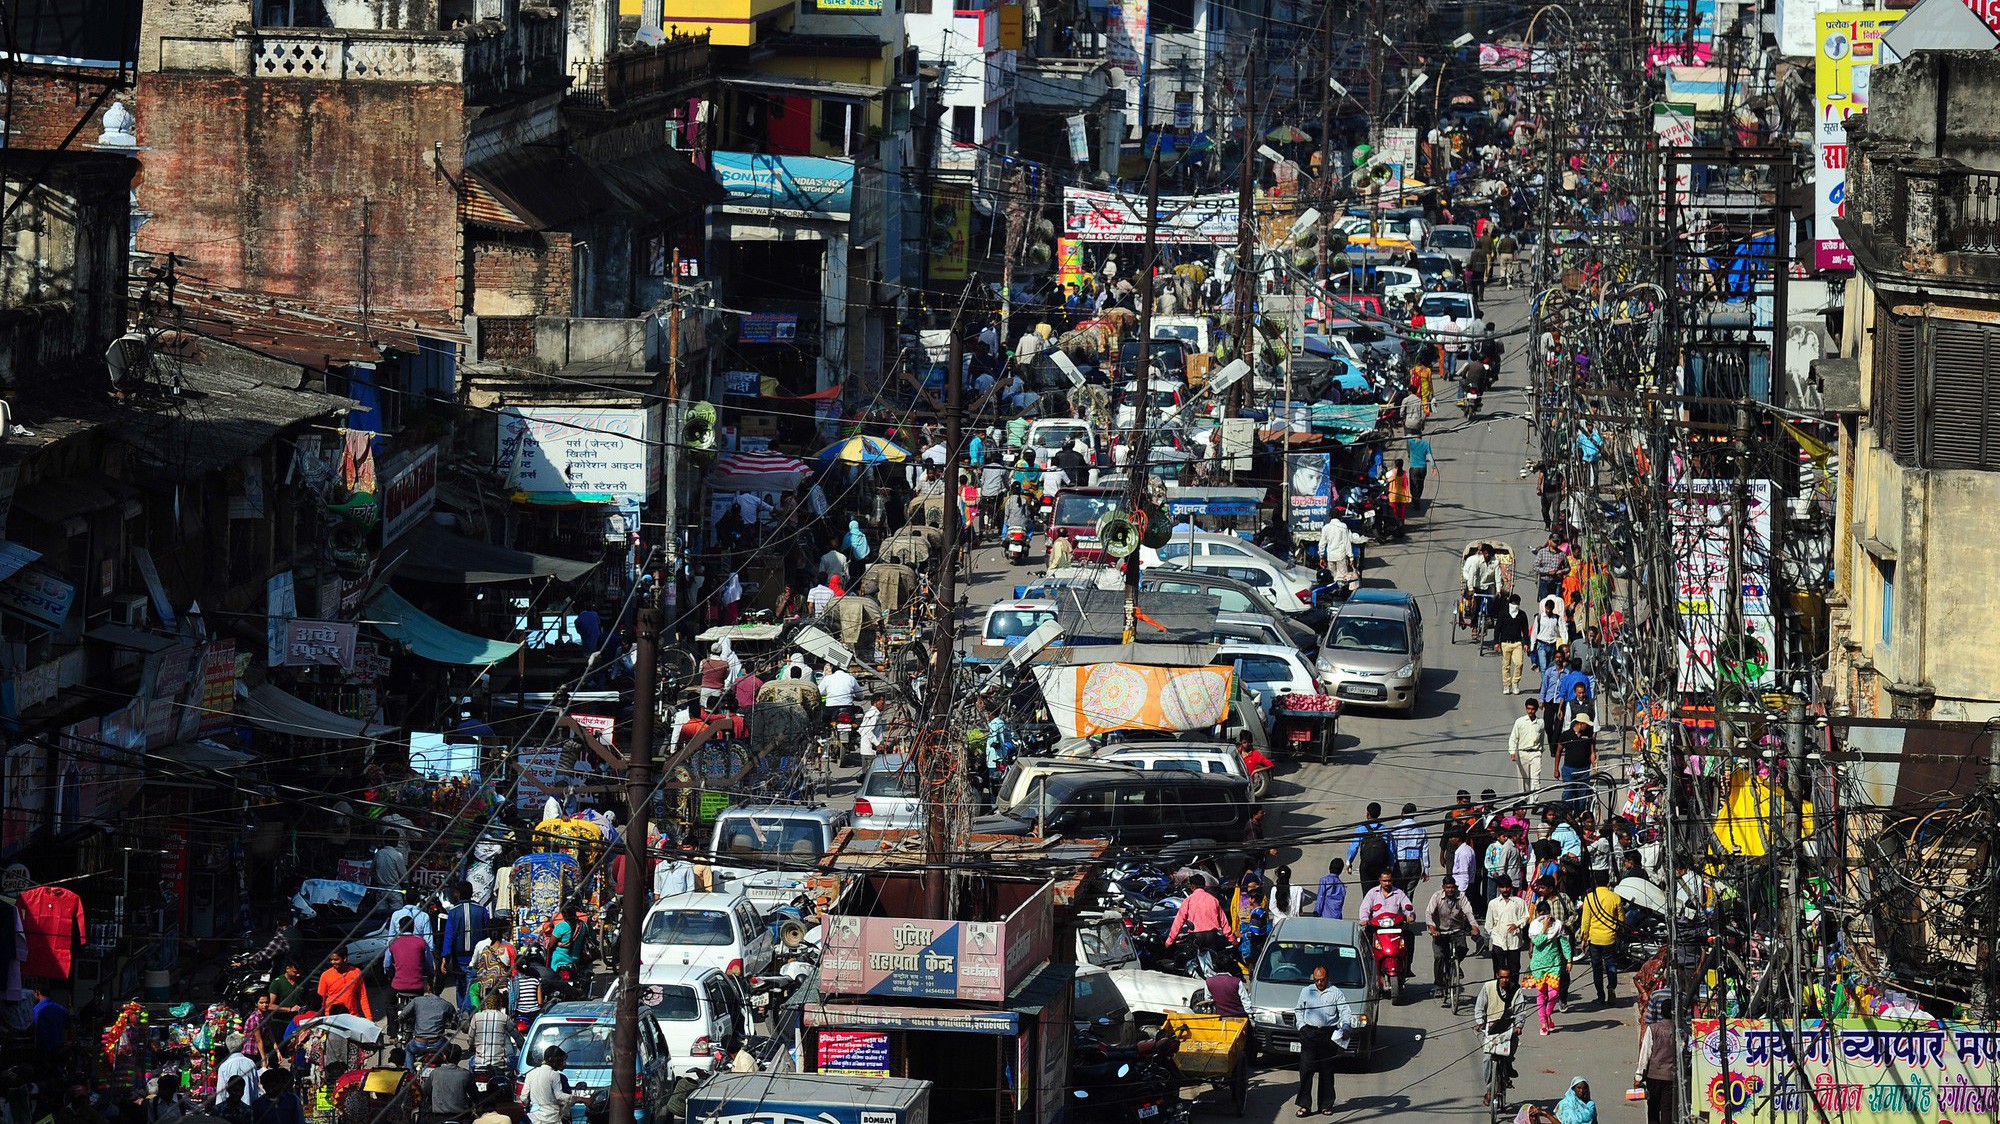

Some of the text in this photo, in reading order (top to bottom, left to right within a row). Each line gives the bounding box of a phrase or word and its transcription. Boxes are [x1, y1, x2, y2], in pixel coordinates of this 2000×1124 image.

[1850, 20, 1857, 41] 1
[721, 171, 777, 187] SONATA
[892, 921, 933, 951] पुलिस
[869, 950, 955, 973] सहायता केन्द्र
[1841, 1031, 1948, 1070] व्यापार
[1869, 1074, 1933, 1114] समारोह
